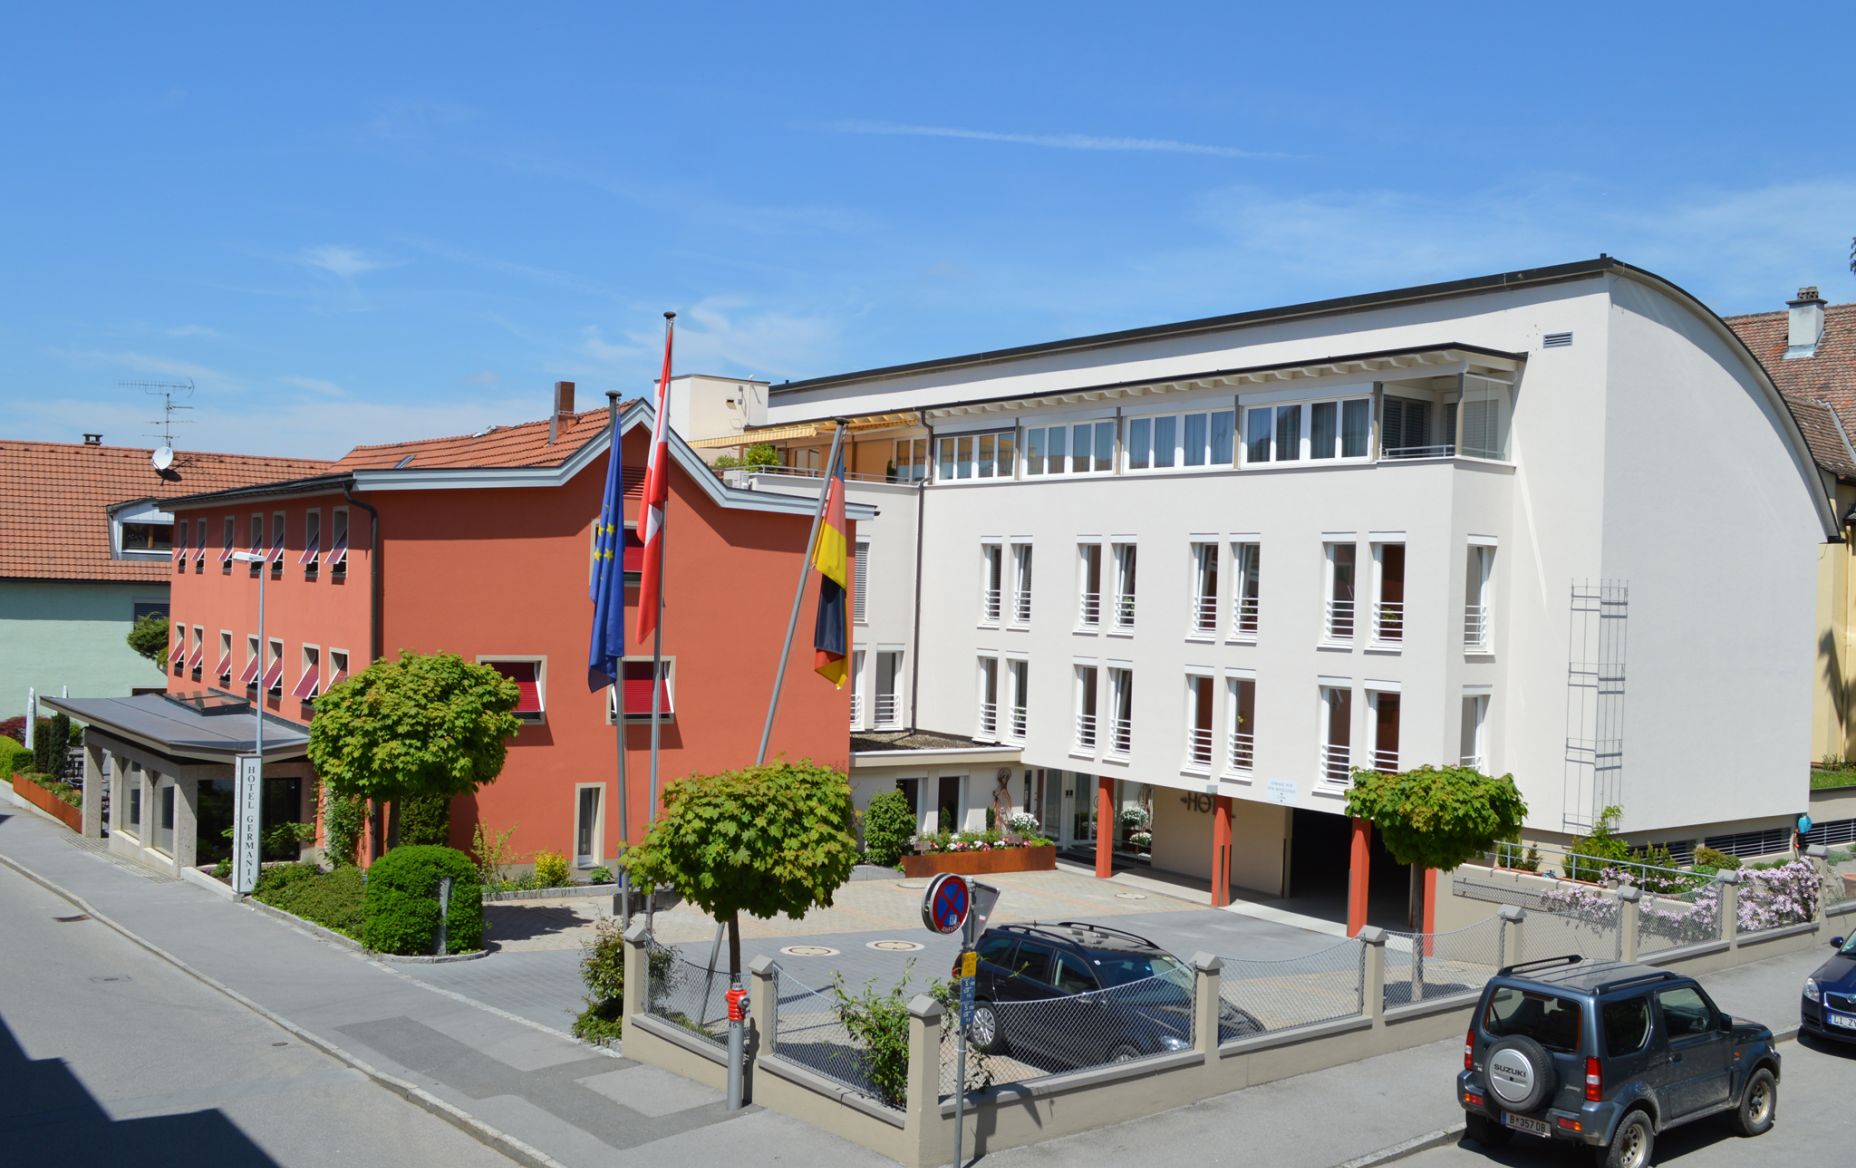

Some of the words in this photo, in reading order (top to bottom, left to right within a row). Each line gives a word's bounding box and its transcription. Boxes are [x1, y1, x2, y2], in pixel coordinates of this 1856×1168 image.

[248, 766, 256, 809] HOTEL
[245, 815, 254, 885] GERMANIA
[1494, 1063, 1526, 1077] SUZUKI
